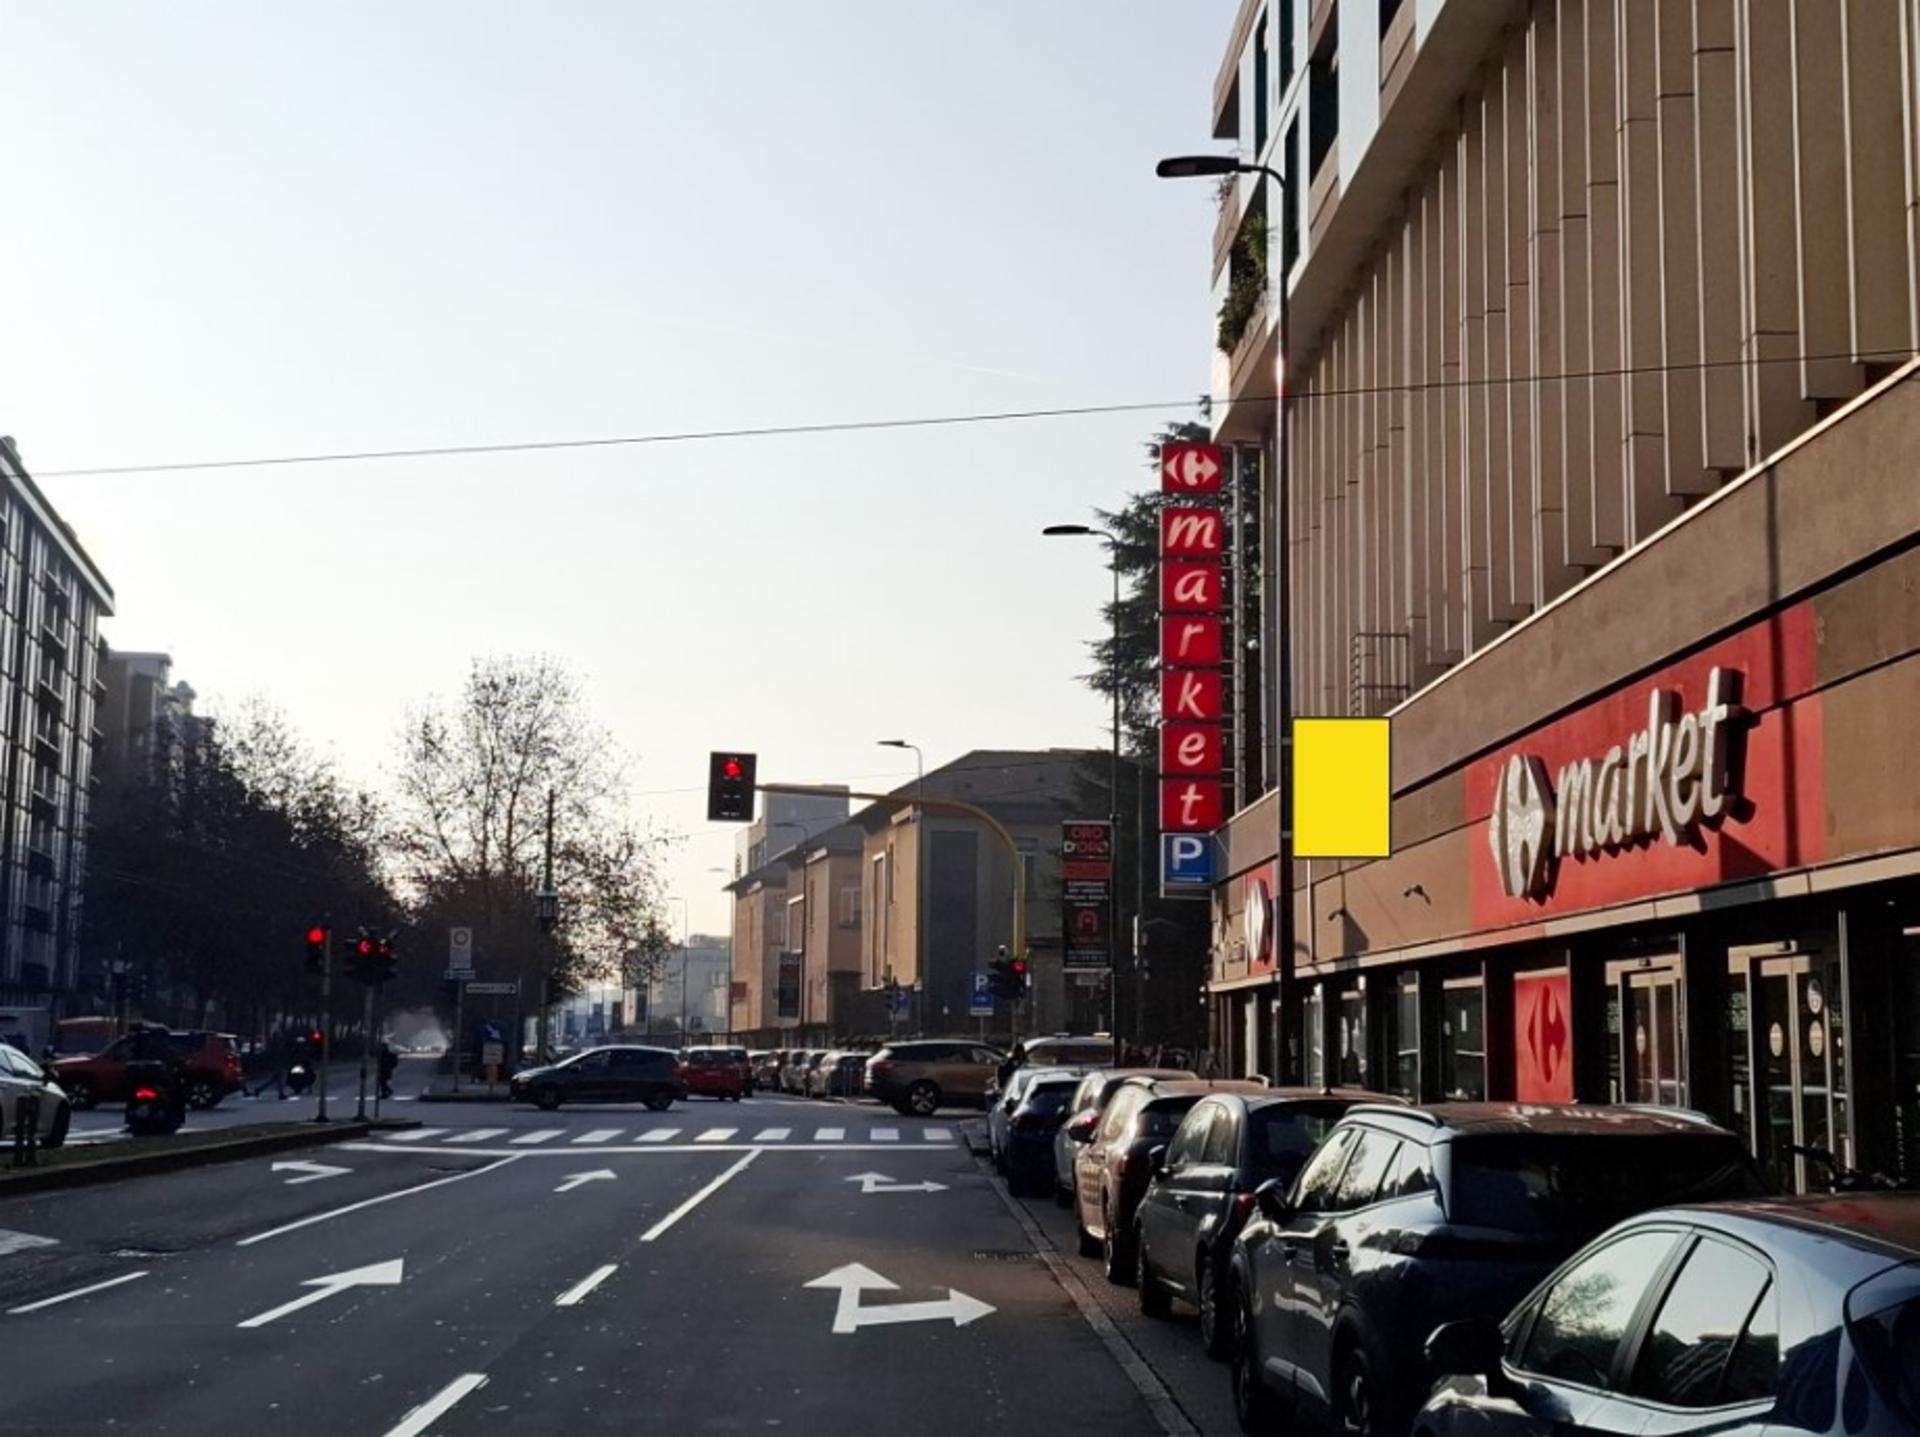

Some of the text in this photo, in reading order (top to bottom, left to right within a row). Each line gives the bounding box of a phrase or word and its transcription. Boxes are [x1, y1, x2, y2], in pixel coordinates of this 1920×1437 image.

[1167, 514, 1217, 827] market
[1555, 665, 1737, 858] market
[1172, 837, 1203, 871] P
[975, 973, 989, 992] P
